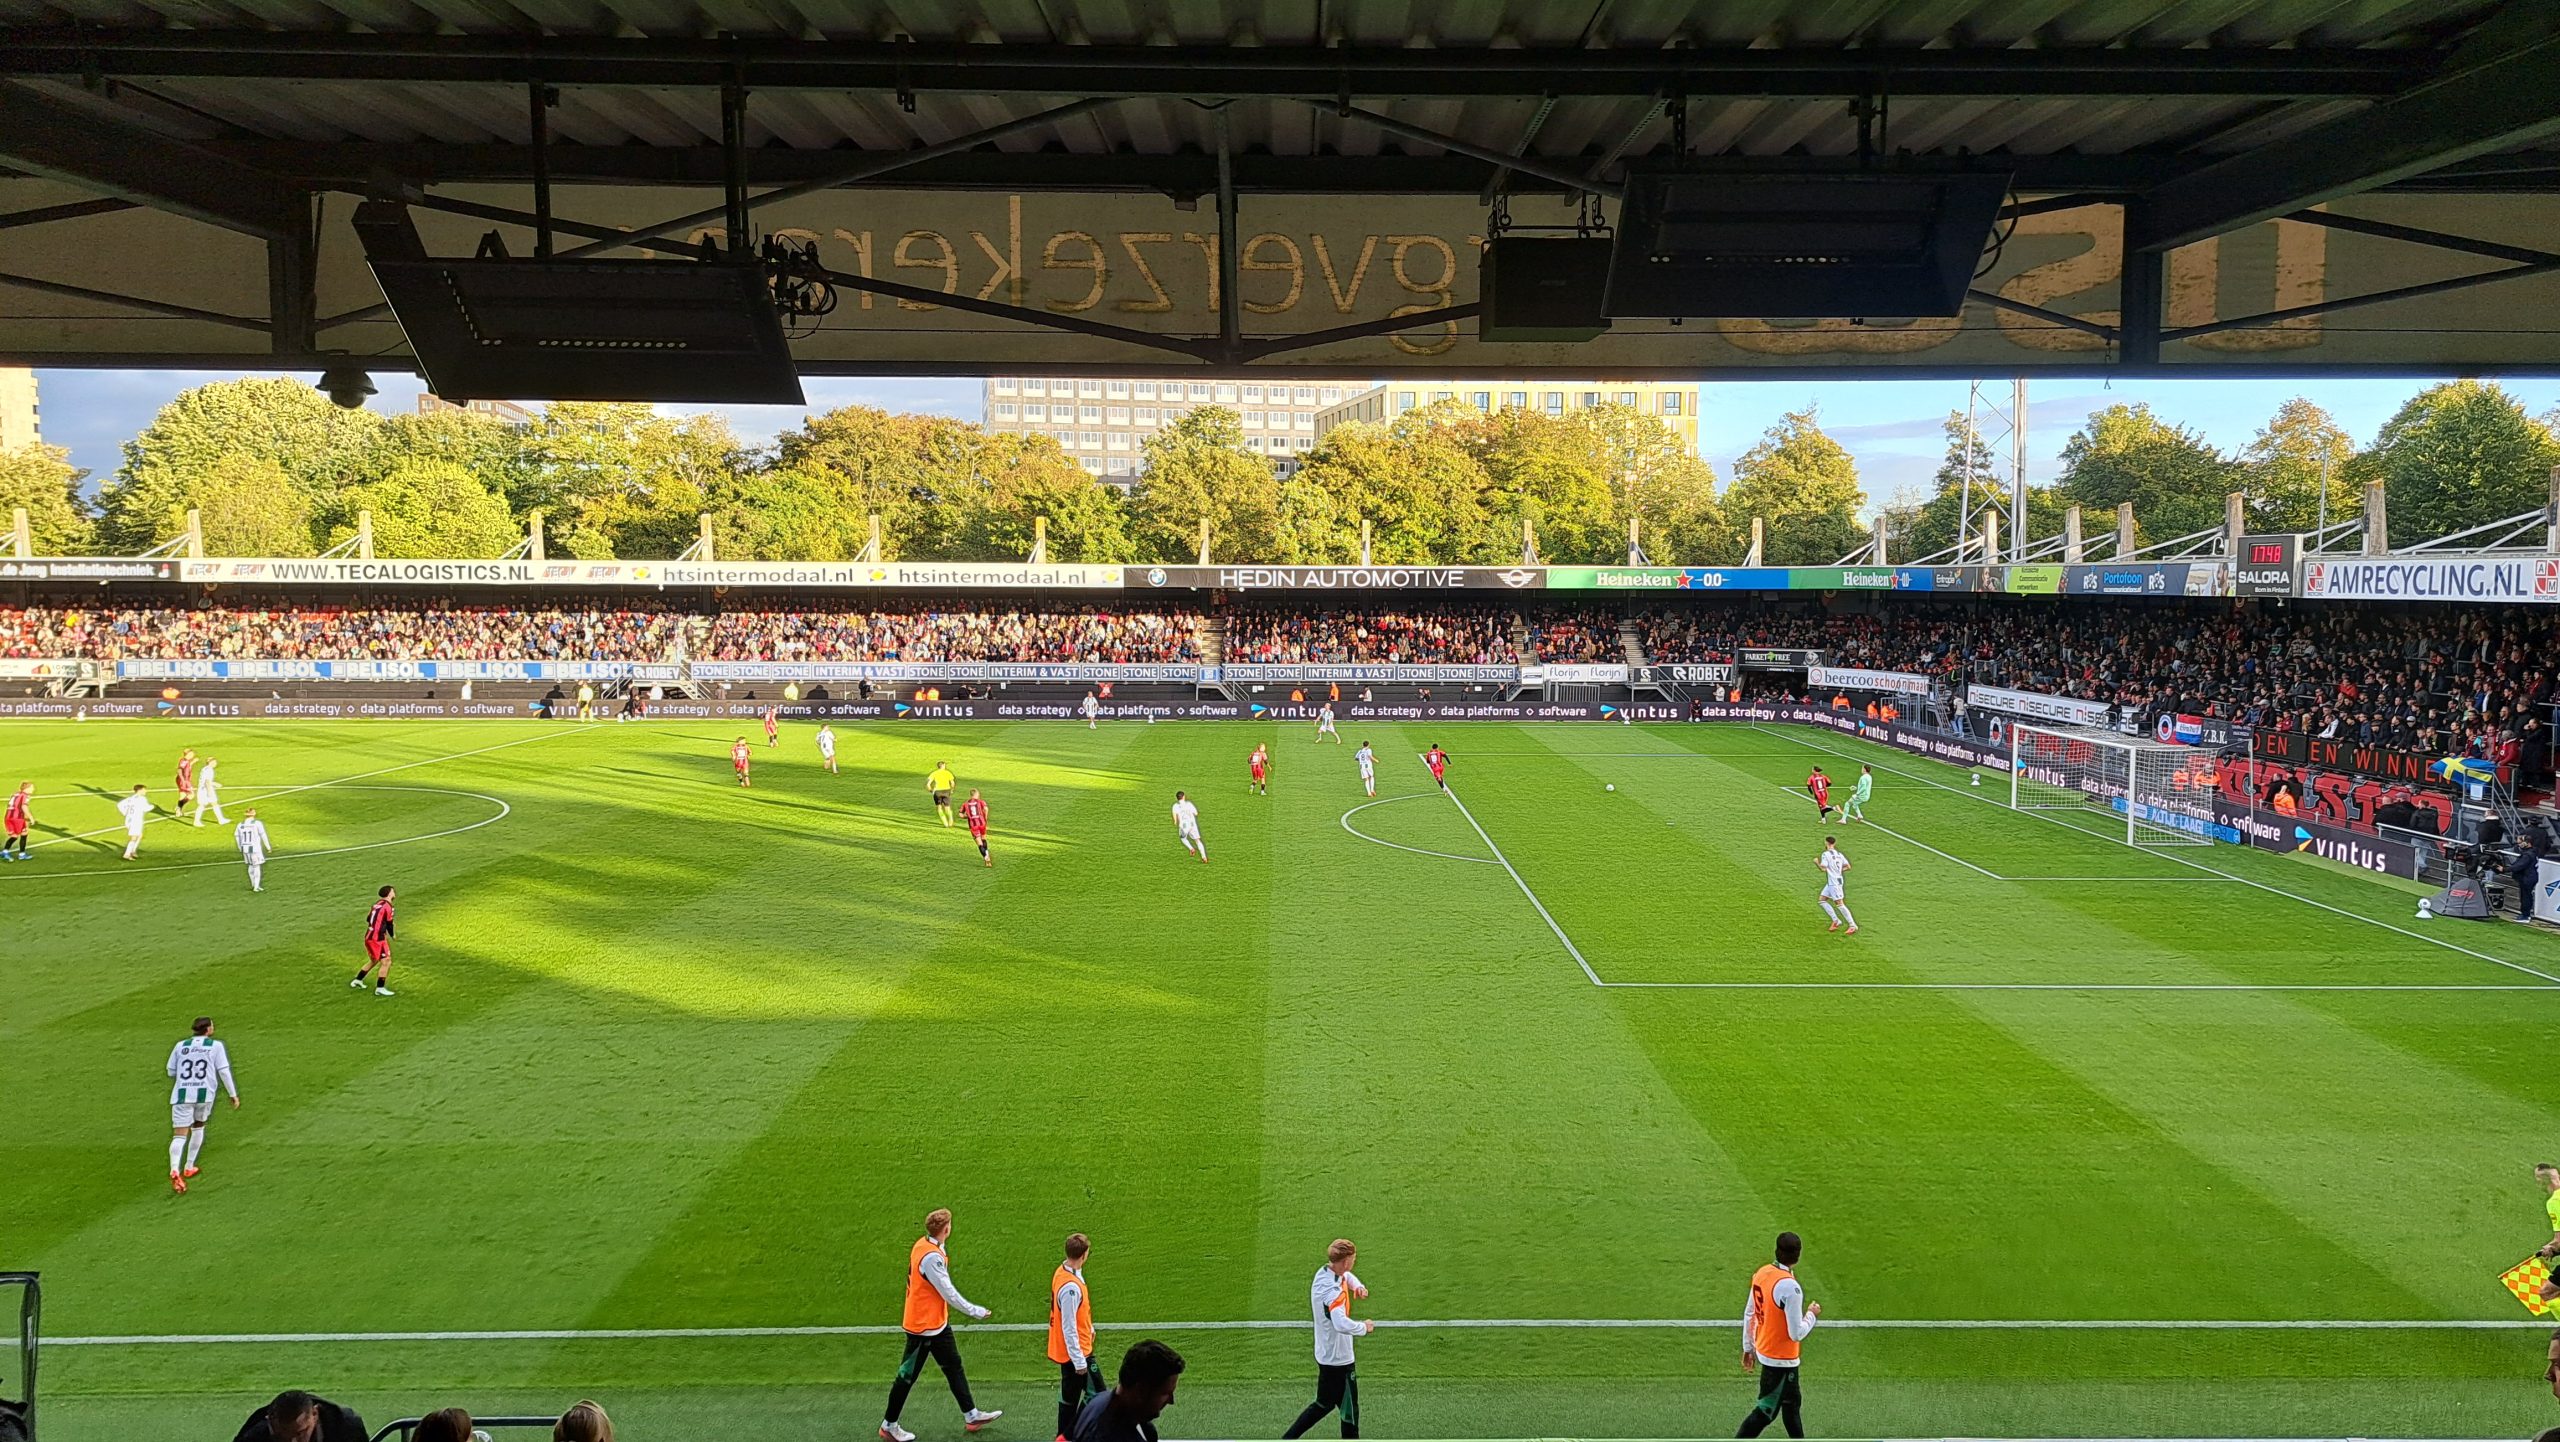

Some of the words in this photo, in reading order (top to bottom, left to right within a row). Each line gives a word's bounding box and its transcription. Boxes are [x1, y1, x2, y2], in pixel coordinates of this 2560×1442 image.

[272, 564, 534, 580] WWW.TECALOGISTICS.NL
[663, 567, 853, 583] htsintermodaal.nl
[899, 569, 1086, 585] htsintermodaal.nl
[1220, 569, 1295, 587] HEDIN
[1303, 569, 1464, 587] AUTOMOTIVE
[2103, 571, 2143, 584] Portofoon
[2238, 571, 2290, 584] SALORA
[1596, 572, 1671, 587] Heineken
[1842, 571, 1889, 588] Heineken
[2328, 564, 2527, 597] AMRECYCLING.NL
[1745, 653, 1767, 661] PARKET
[139, 661, 217, 677] BELISOL
[243, 662, 321, 678] BELISOL
[347, 662, 424, 678] BELISOL
[451, 663, 529, 679] BELISOL
[646, 665, 680, 680] ROBEY
[693, 665, 729, 677] STONE
[733, 665, 769, 677] STONE
[774, 666, 809, 677] STONE
[816, 666, 860, 677] INTERIM
[876, 666, 904, 677] VAST
[909, 667, 945, 678] STONE
[950, 667, 986, 678] STONE
[991, 667, 1038, 678] INTERIM
[1040, 667, 1048, 678] &
[1050, 667, 1078, 678] VAST
[1084, 667, 1118, 678] STONE
[1123, 667, 1157, 678] STONE
[1162, 667, 1196, 678] STONE
[1227, 667, 1261, 679] STONE
[1267, 667, 1300, 679] STONE
[1308, 667, 1352, 678] INTERIM
[1355, 667, 1363, 678] &
[1365, 667, 1393, 678] VAST
[1400, 667, 1433, 679] STONE
[1439, 667, 1473, 679] STONE
[1479, 667, 1513, 679] STONE
[1550, 666, 1580, 680] florijn
[1590, 666, 1621, 680] florijn
[1688, 666, 1729, 681] ROBEY
[0, 703, 13, 713] ta
[16, 703, 72, 715] platforms
[92, 703, 144, 714] software
[178, 703, 240, 716] vintus
[265, 704, 291, 714] data
[293, 704, 341, 716] strategy
[361, 704, 387, 714] data
[389, 704, 444, 716] platforms
[463, 704, 514, 715] software
[550, 705, 609, 716] vinus
[657, 704, 710, 716] strategy
[730, 704, 755, 714] data
[831, 704, 880, 715] software
[914, 704, 974, 717] vintus
[998, 704, 1023, 715] data
[1025, 704, 1072, 717] strategy
[1117, 705, 1171, 717] platforms
[1189, 705, 1237, 716] software
[1351, 706, 1375, 716] data
[1377, 706, 1422, 718] strategy
[1441, 706, 1465, 716] data
[1467, 706, 1520, 718] platforms
[1538, 706, 1587, 717] software
[1619, 706, 1678, 718] vintus
[1702, 707, 1727, 717] data
[1729, 707, 1776, 720] strategy
[1793, 710, 1812, 720] data
[1865, 723, 1889, 741] vintus
[1896, 730, 1912, 744] data
[1913, 734, 1928, 752] strategy
[1935, 739, 1948, 756] data
[1948, 742, 1975, 762] platforms
[1983, 753, 2010, 771] software
[2028, 765, 2065, 787] vintus
[242, 831, 252, 842] 11
[2315, 837, 2386, 873] vintus
[180, 1058, 208, 1081] 33
